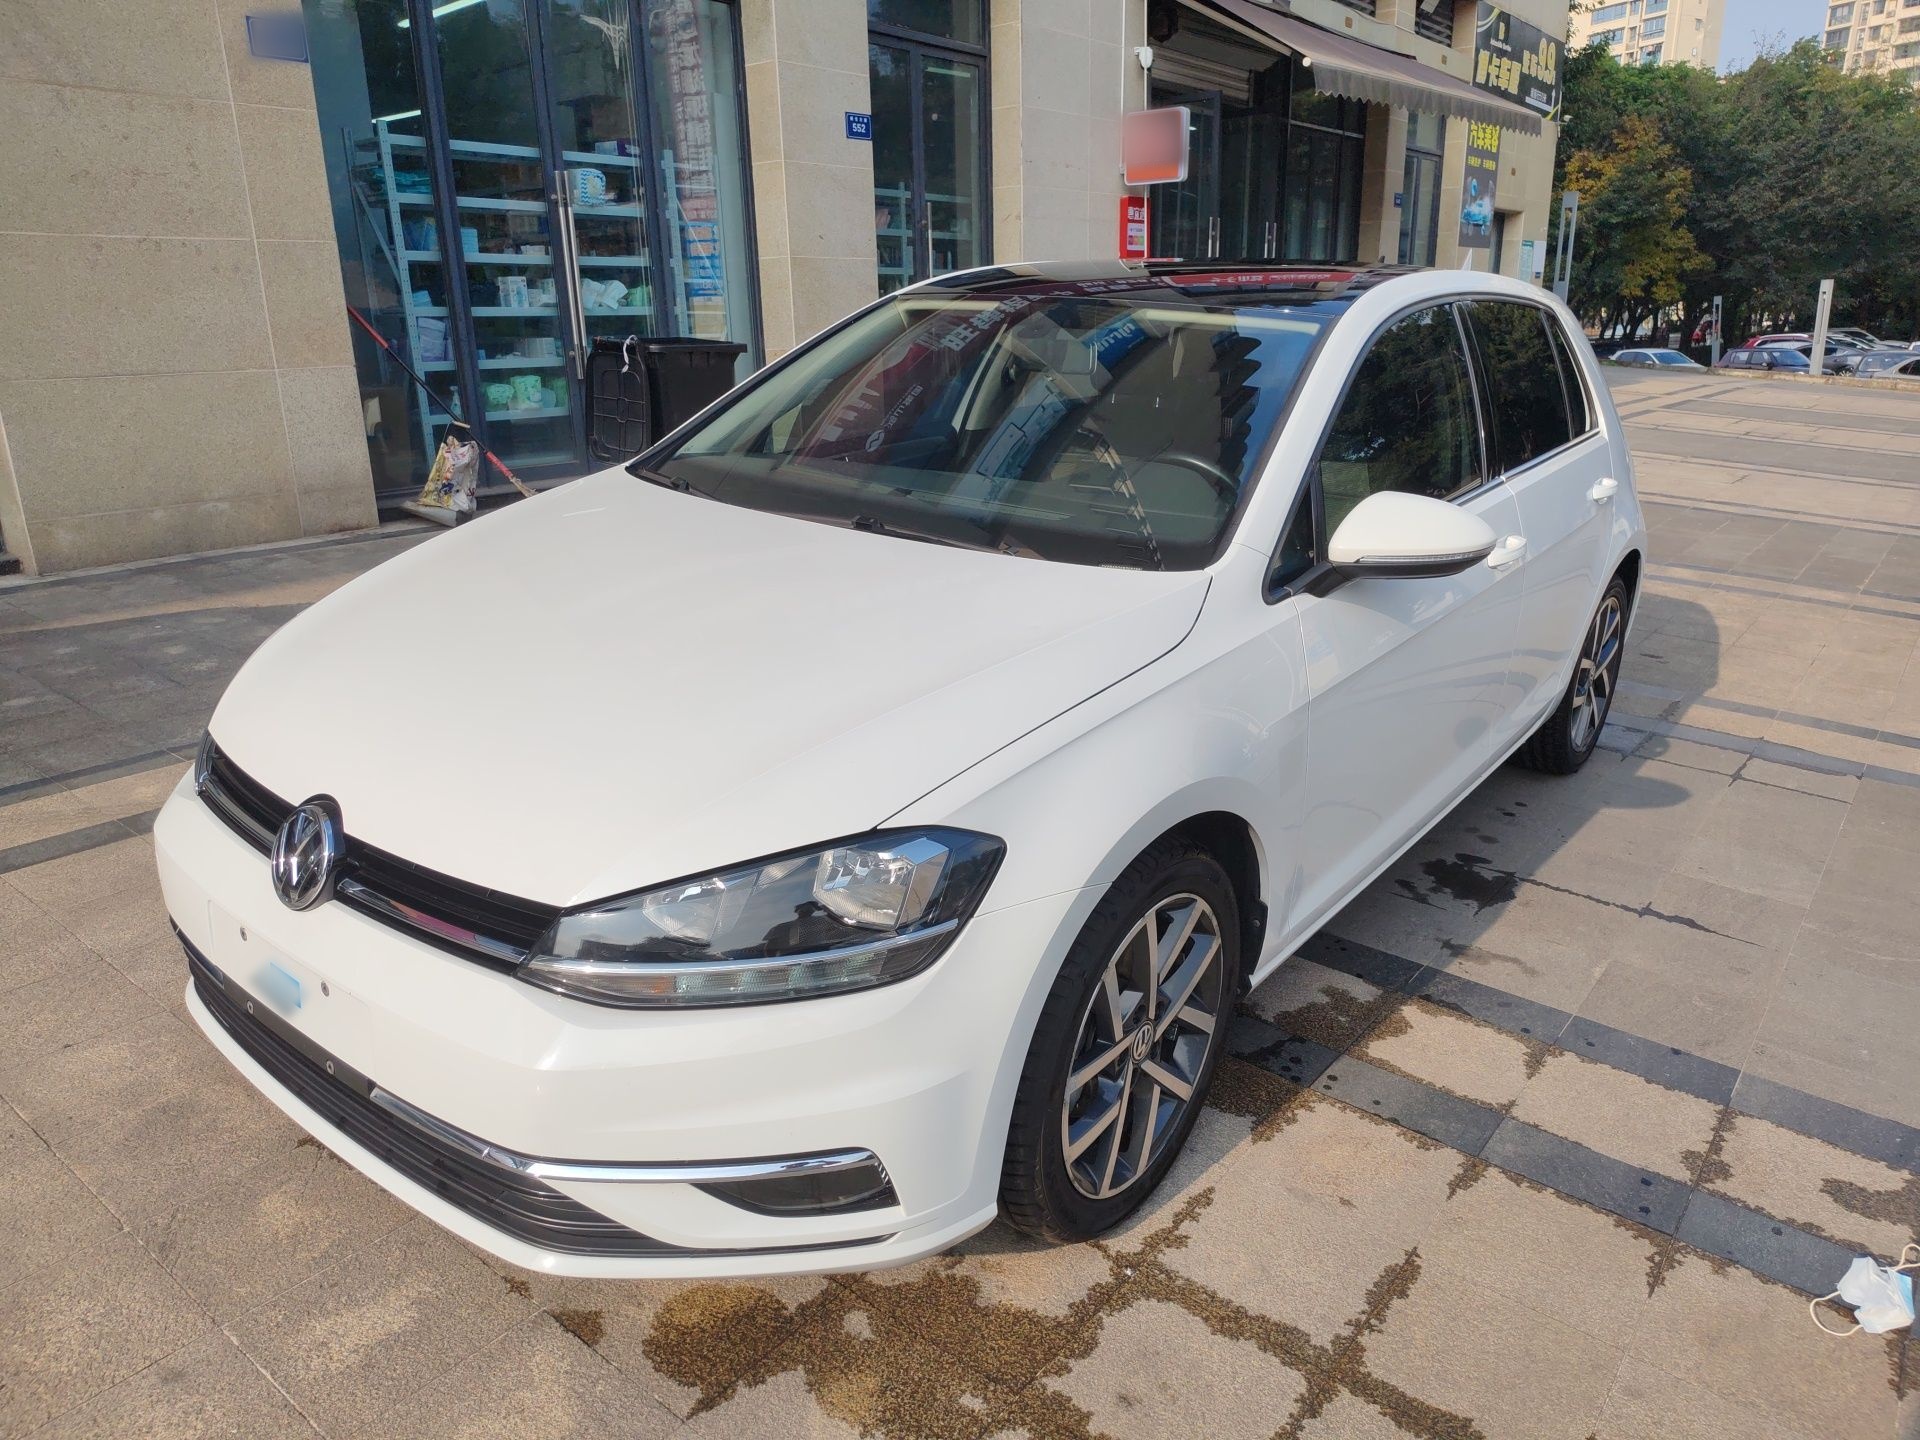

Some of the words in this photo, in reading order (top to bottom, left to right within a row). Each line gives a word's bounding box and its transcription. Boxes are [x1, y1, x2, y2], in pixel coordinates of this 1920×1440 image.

[852, 122, 866, 133] 552
[1469, 119, 1499, 153] 汽车美容
